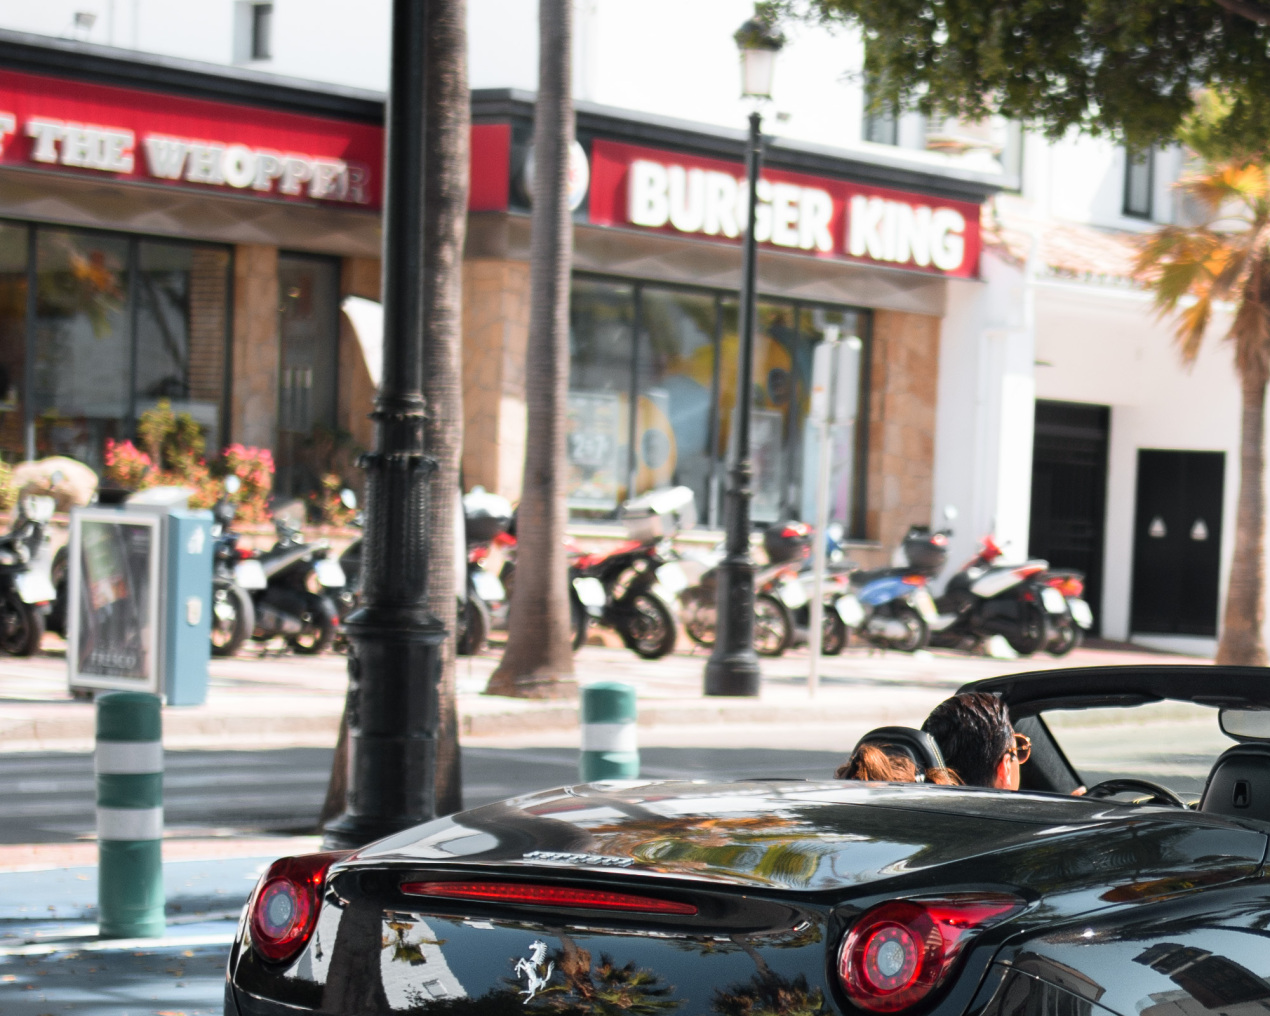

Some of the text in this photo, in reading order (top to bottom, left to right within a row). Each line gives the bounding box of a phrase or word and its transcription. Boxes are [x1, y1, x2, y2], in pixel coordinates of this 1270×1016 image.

[26, 116, 135, 173] THE
[144, 133, 370, 204] WHOPPER
[628, 159, 965, 270] BURGER KING
